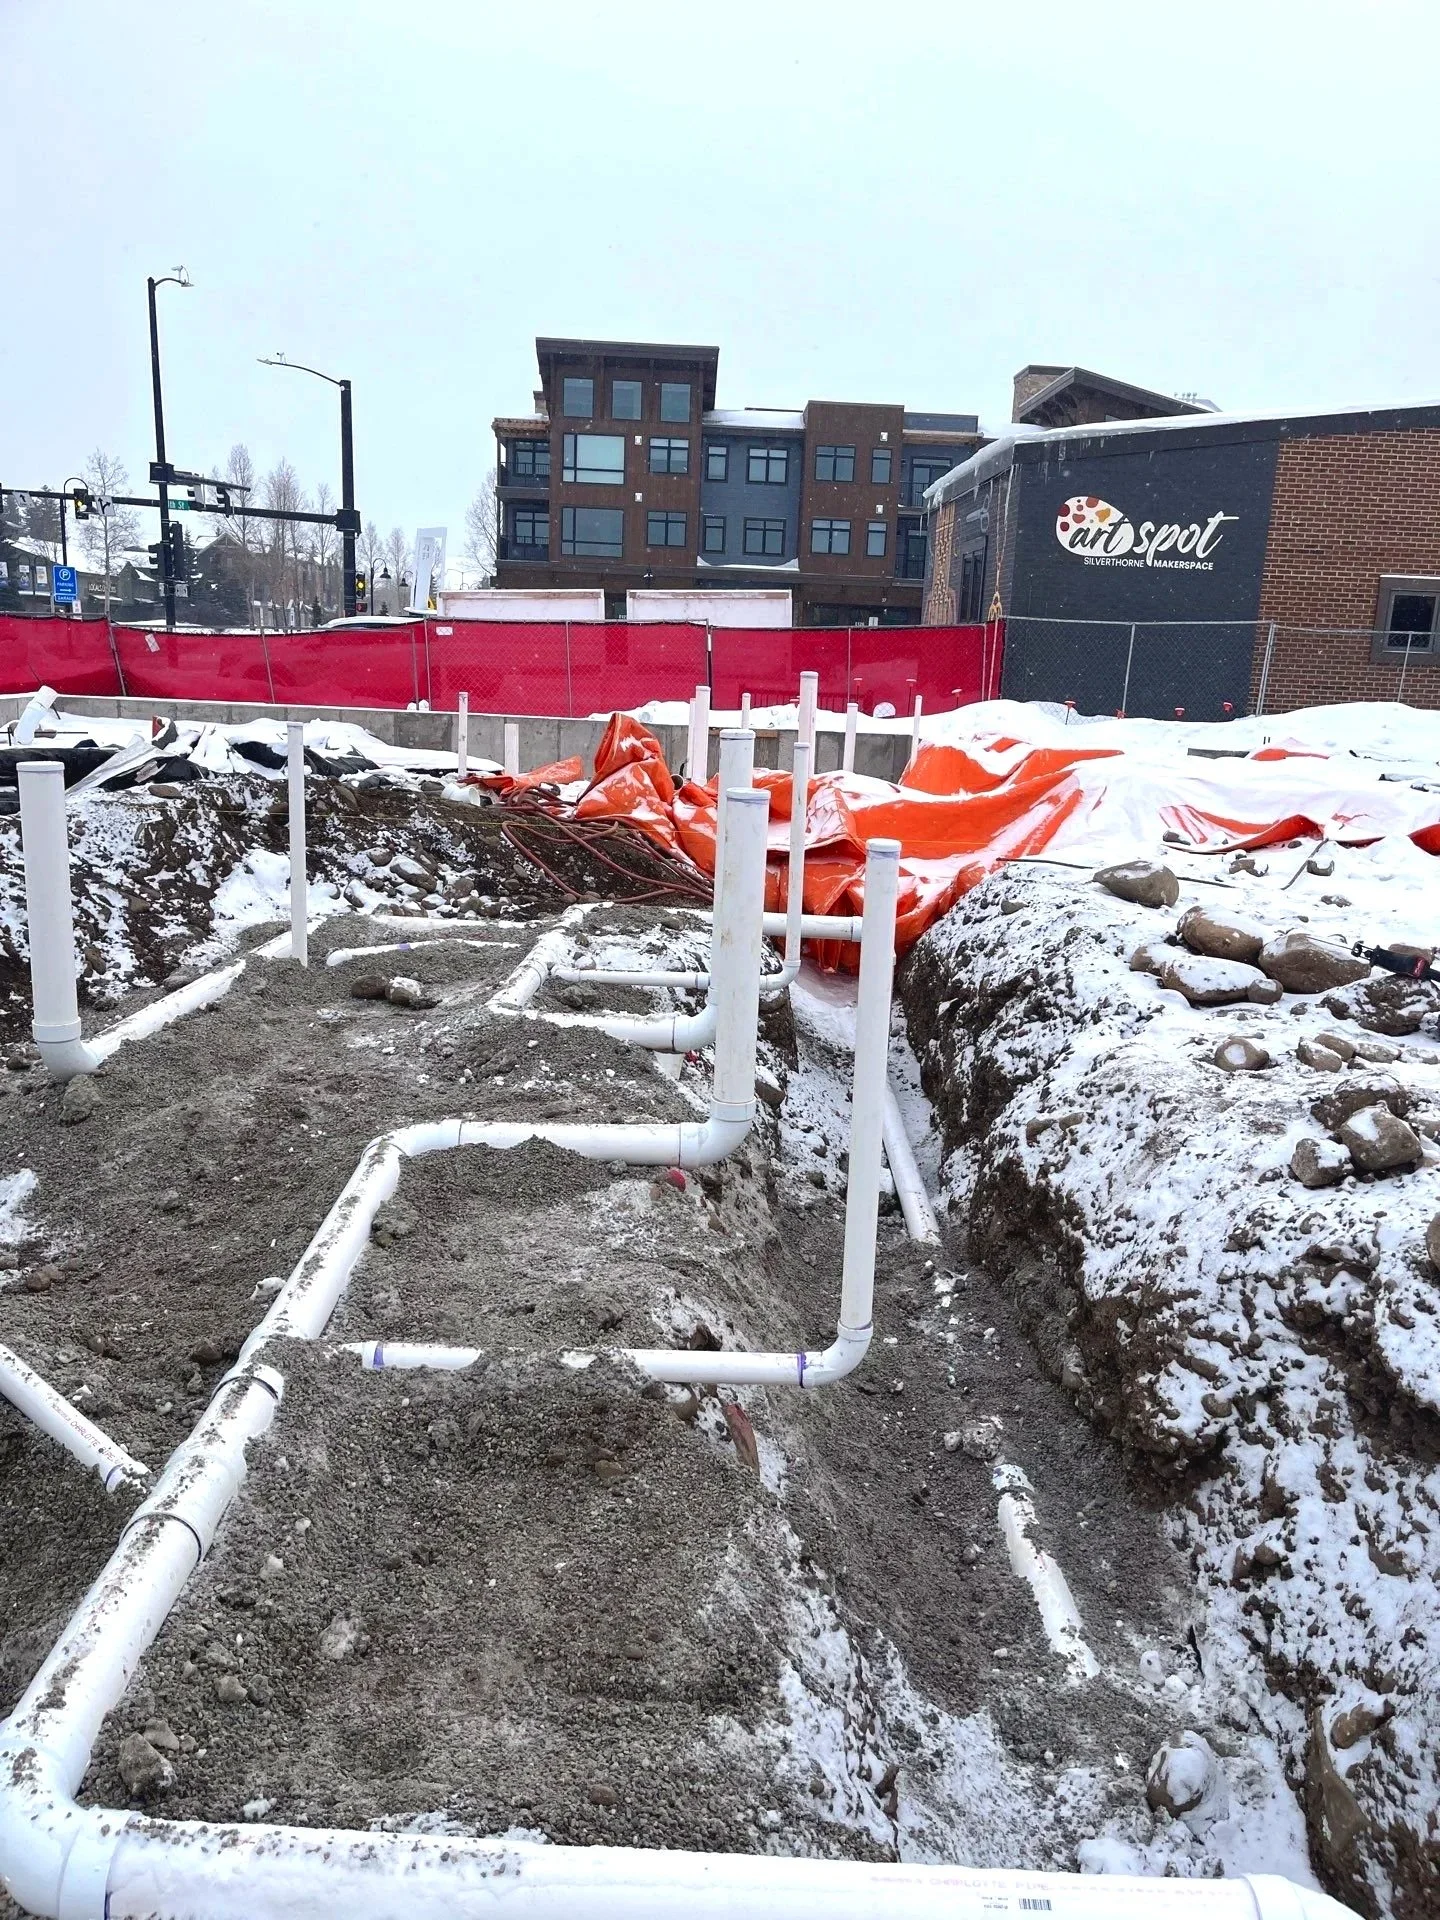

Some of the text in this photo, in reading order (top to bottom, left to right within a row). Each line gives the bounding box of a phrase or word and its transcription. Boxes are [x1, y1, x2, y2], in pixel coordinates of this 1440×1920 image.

[1069, 511, 1240, 566] art spot
[1084, 556, 1214, 571] SILVERTHORNE MAKERSPACE
[71, 1421, 100, 1447] CHARLOTTE
